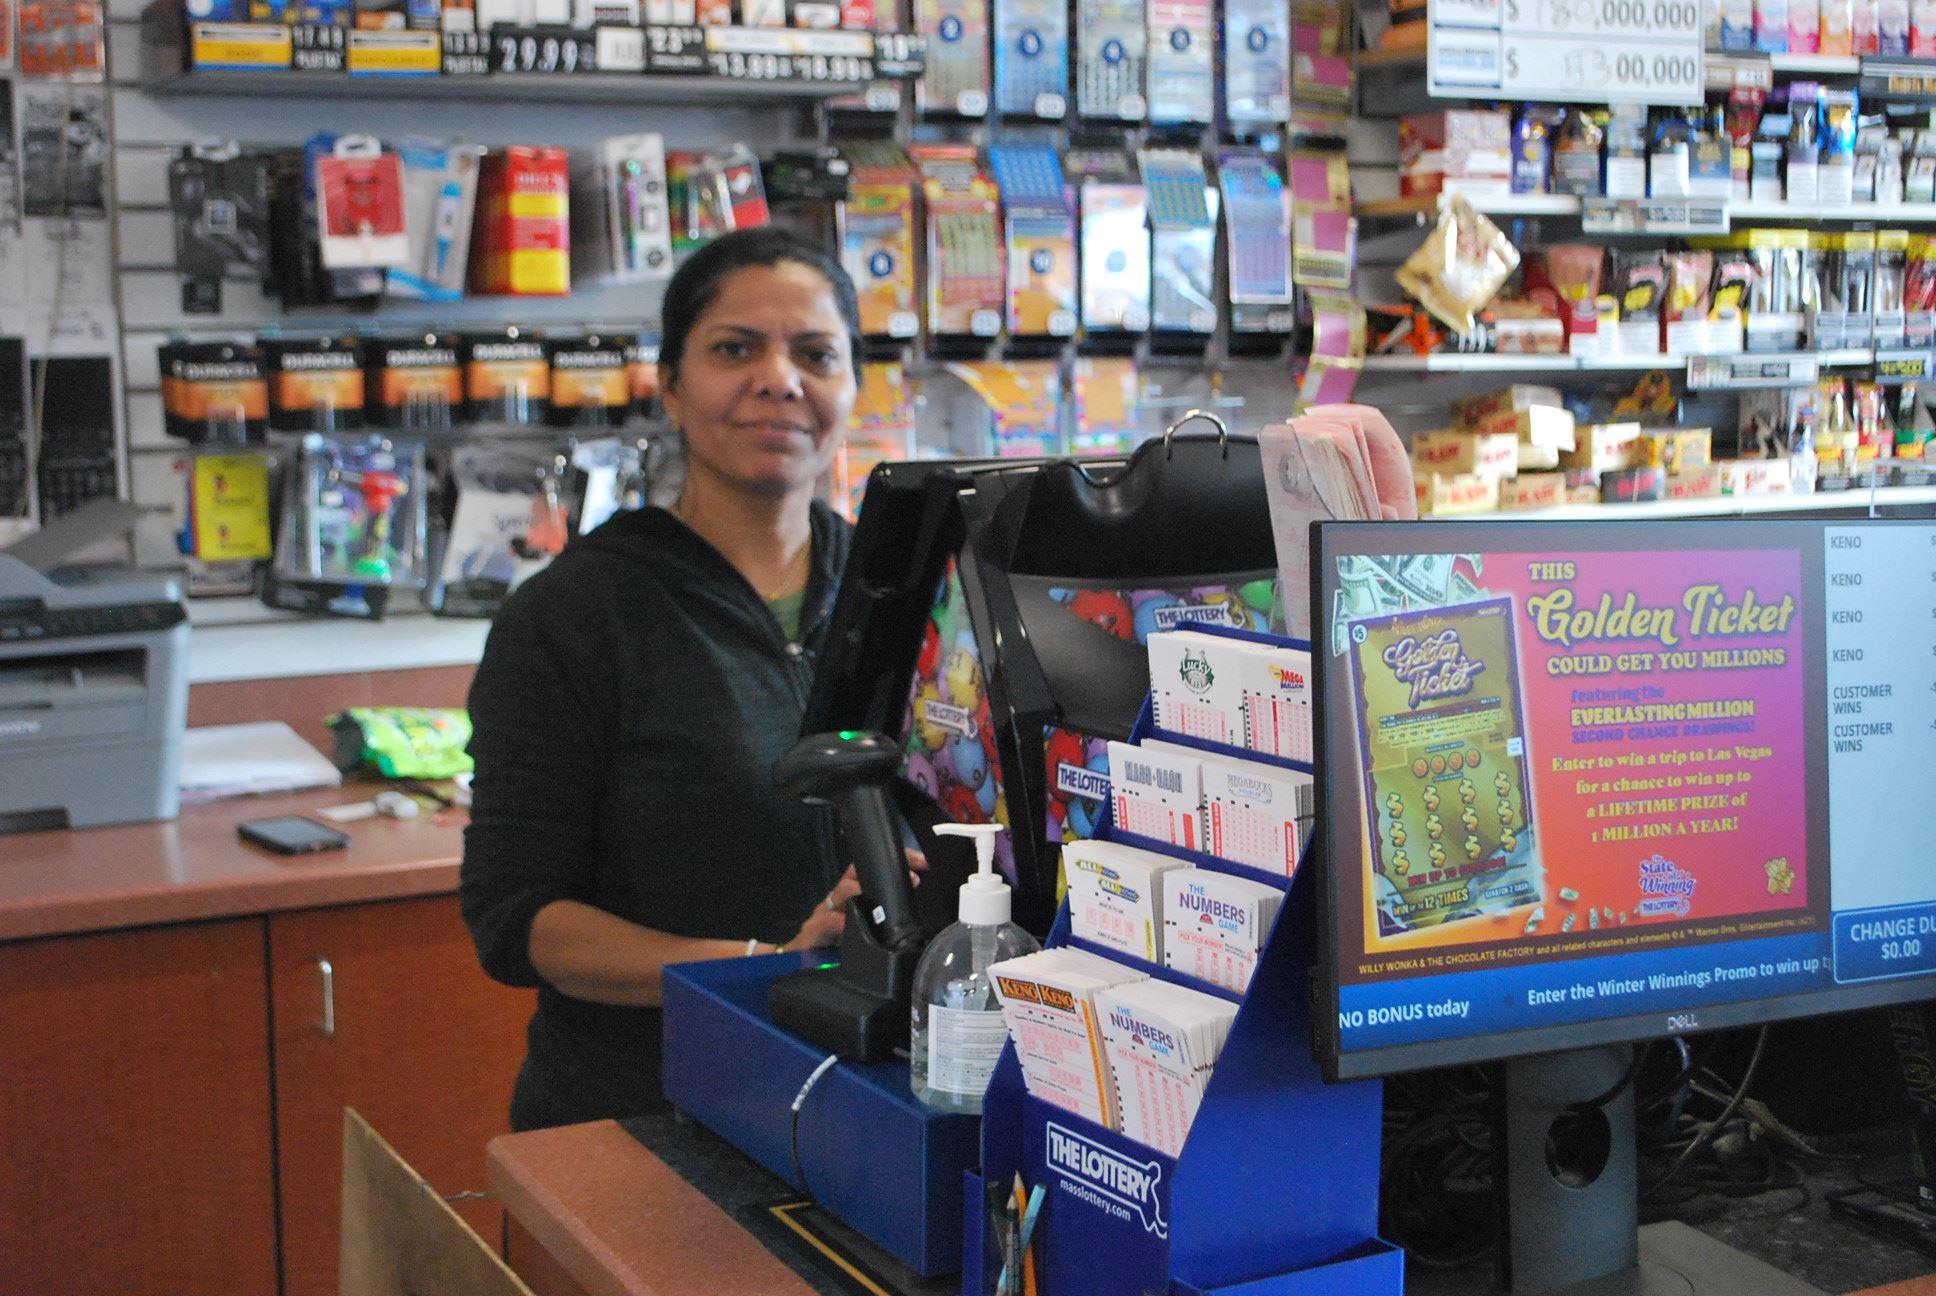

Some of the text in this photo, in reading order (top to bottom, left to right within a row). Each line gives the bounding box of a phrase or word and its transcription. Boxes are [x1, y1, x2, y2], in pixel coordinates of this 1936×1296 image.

[1507, 48, 1519, 78] $
[1616, 53, 1696, 86] 00,000
[1831, 536, 1861, 549] KENO
[1528, 562, 1575, 580] THIS
[1831, 573, 1862, 586] KENO
[1157, 607, 1227, 624] THE LOTTERY
[1527, 584, 1794, 646] Golden Ticket
[1832, 611, 1863, 624] KENO
[1547, 648, 1785, 674] COULD GET YOU MILLIONS
[1833, 649, 1864, 662] KENO
[1280, 669, 1304, 683] MEGA
[1409, 656, 1483, 708] Ticket
[1643, 687, 1664, 699] the
[1833, 684, 1892, 700] CUSTOMER
[1571, 700, 1754, 726] EVERLASTING MILLION
[1833, 701, 1862, 715] WINS
[1573, 729, 1624, 743] SECOND
[1628, 725, 1678, 740] CHANCE
[1834, 722, 1893, 738] CUSTOMER
[1834, 739, 1863, 753] WINS
[1552, 745, 1772, 771] Enter to win a trip to Las Vegas
[1060, 770, 1078, 788] THE
[1576, 771, 1751, 795] for a chance to win up to
[1587, 792, 1748, 818] a LIFETIME PRIZE of
[1602, 822, 1672, 841] MILLION
[1676, 822, 1687, 834] A
[1690, 817, 1739, 833] YEAR!
[1641, 860, 1674, 875] State
[1189, 884, 1205, 895] THE
[1640, 878, 1696, 895] Winning
[1425, 895, 1435, 908] 12
[1438, 888, 1469, 905] TIMES
[1180, 892, 1245, 925] NUMBERS
[1219, 918, 1239, 933] GAME
[1850, 918, 1916, 942] CHANGE
[1359, 964, 1385, 975] WILLY
[1387, 960, 1418, 972] WONKA
[1419, 959, 1426, 968] &
[1428, 957, 1444, 967] THE
[1445, 951, 1495, 965] CHOCOLATE
[1497, 946, 1535, 959] FACTORY
[1537, 945, 1550, 955] and
[1552, 944, 1561, 954] all
[1562, 941, 1586, 953] related
[1588, 938, 1624, 949] characters
[1626, 936, 1639, 946] and
[1881, 939, 1920, 960] $0.00
[1528, 987, 1568, 1005] Enter
[1570, 984, 1595, 999] the
[1598, 977, 1645, 996] Winter
[1648, 970, 1711, 988] Winnings
[1714, 964, 1756, 981] Promo
[1760, 963, 1773, 976] to
[1776, 958, 1800, 974] win
[1803, 959, 1819, 973] up
[1000, 977, 1074, 1009] KENO KENO
[1116, 1006, 1131, 1016] THE
[1339, 999, 1470, 1029] NO BONUS today
[1110, 1013, 1174, 1050] NUMBERS
[1668, 1015, 1698, 1030] DELL
[1149, 1041, 1169, 1056] GAME
[1051, 1130, 1151, 1203] THE LOTTERY
[1060, 1179, 1131, 1221] masslottery.com
